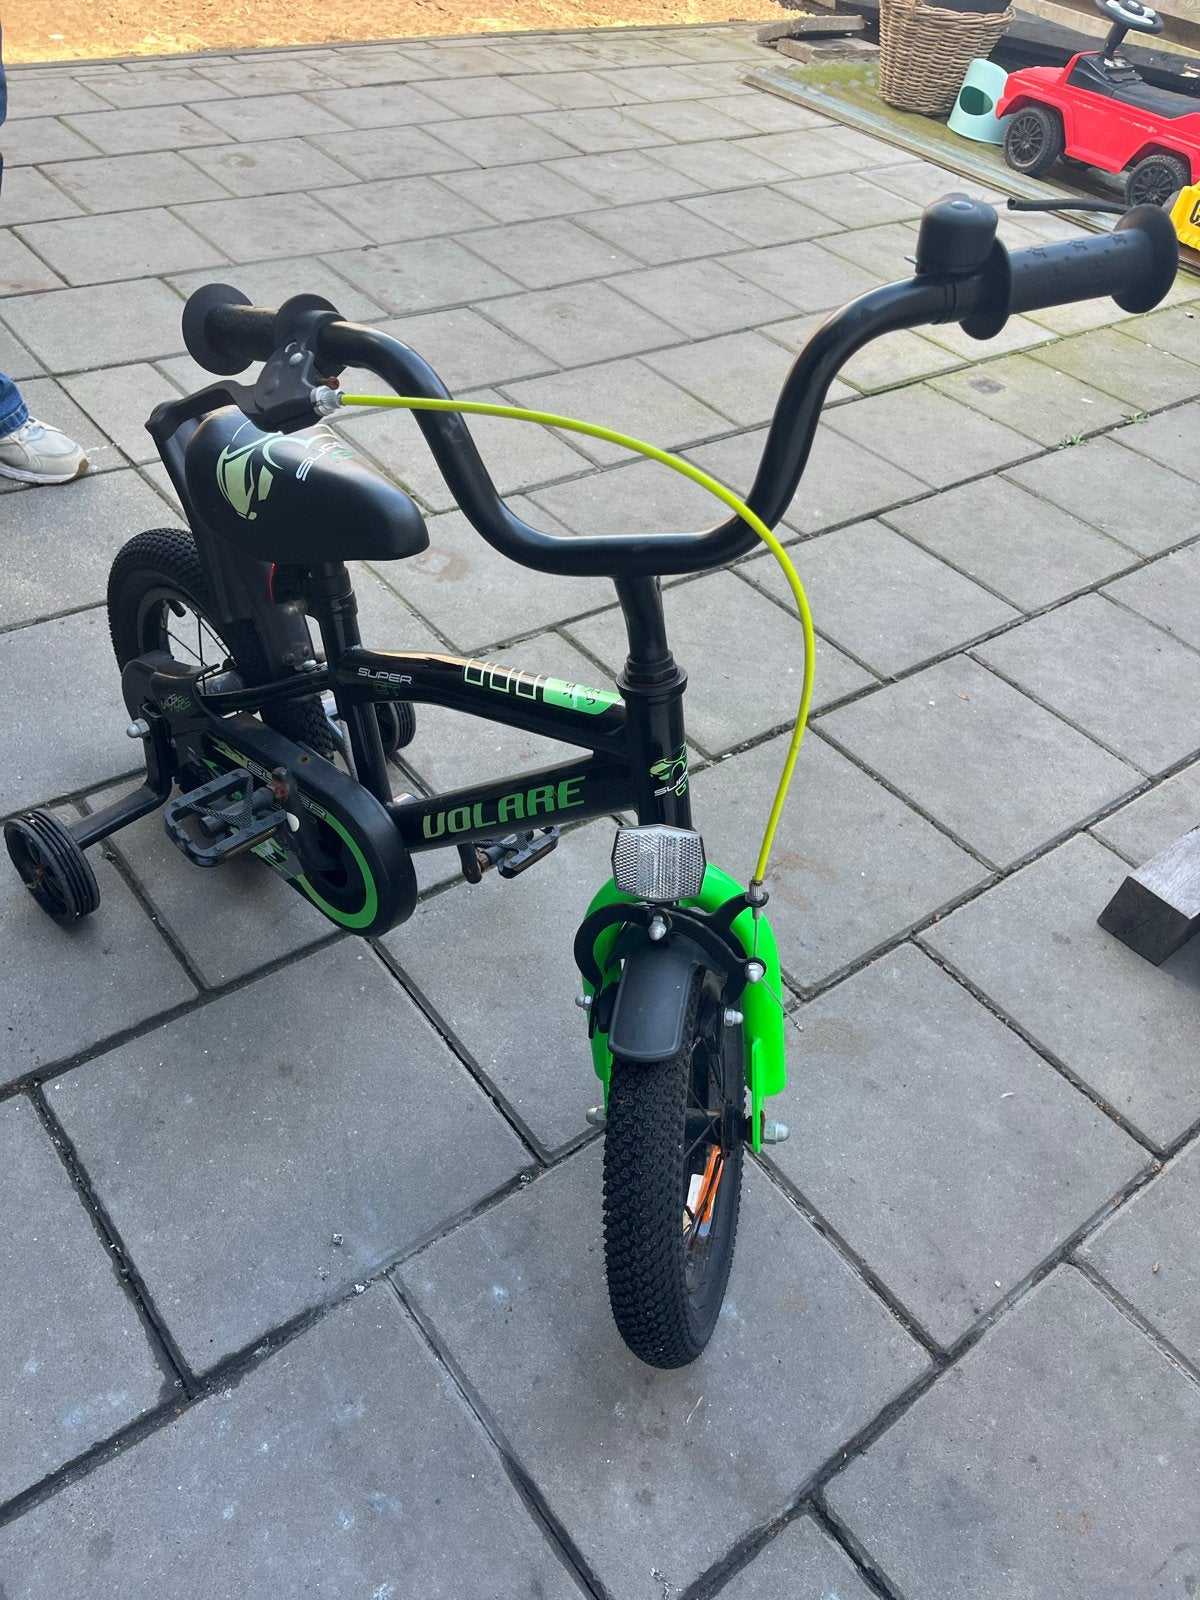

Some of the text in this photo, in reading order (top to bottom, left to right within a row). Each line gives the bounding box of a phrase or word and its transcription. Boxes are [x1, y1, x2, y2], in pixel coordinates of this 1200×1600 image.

[357, 667, 412, 685] SUPER
[371, 681, 401, 696] GT
[422, 775, 586, 839] VOLARE
